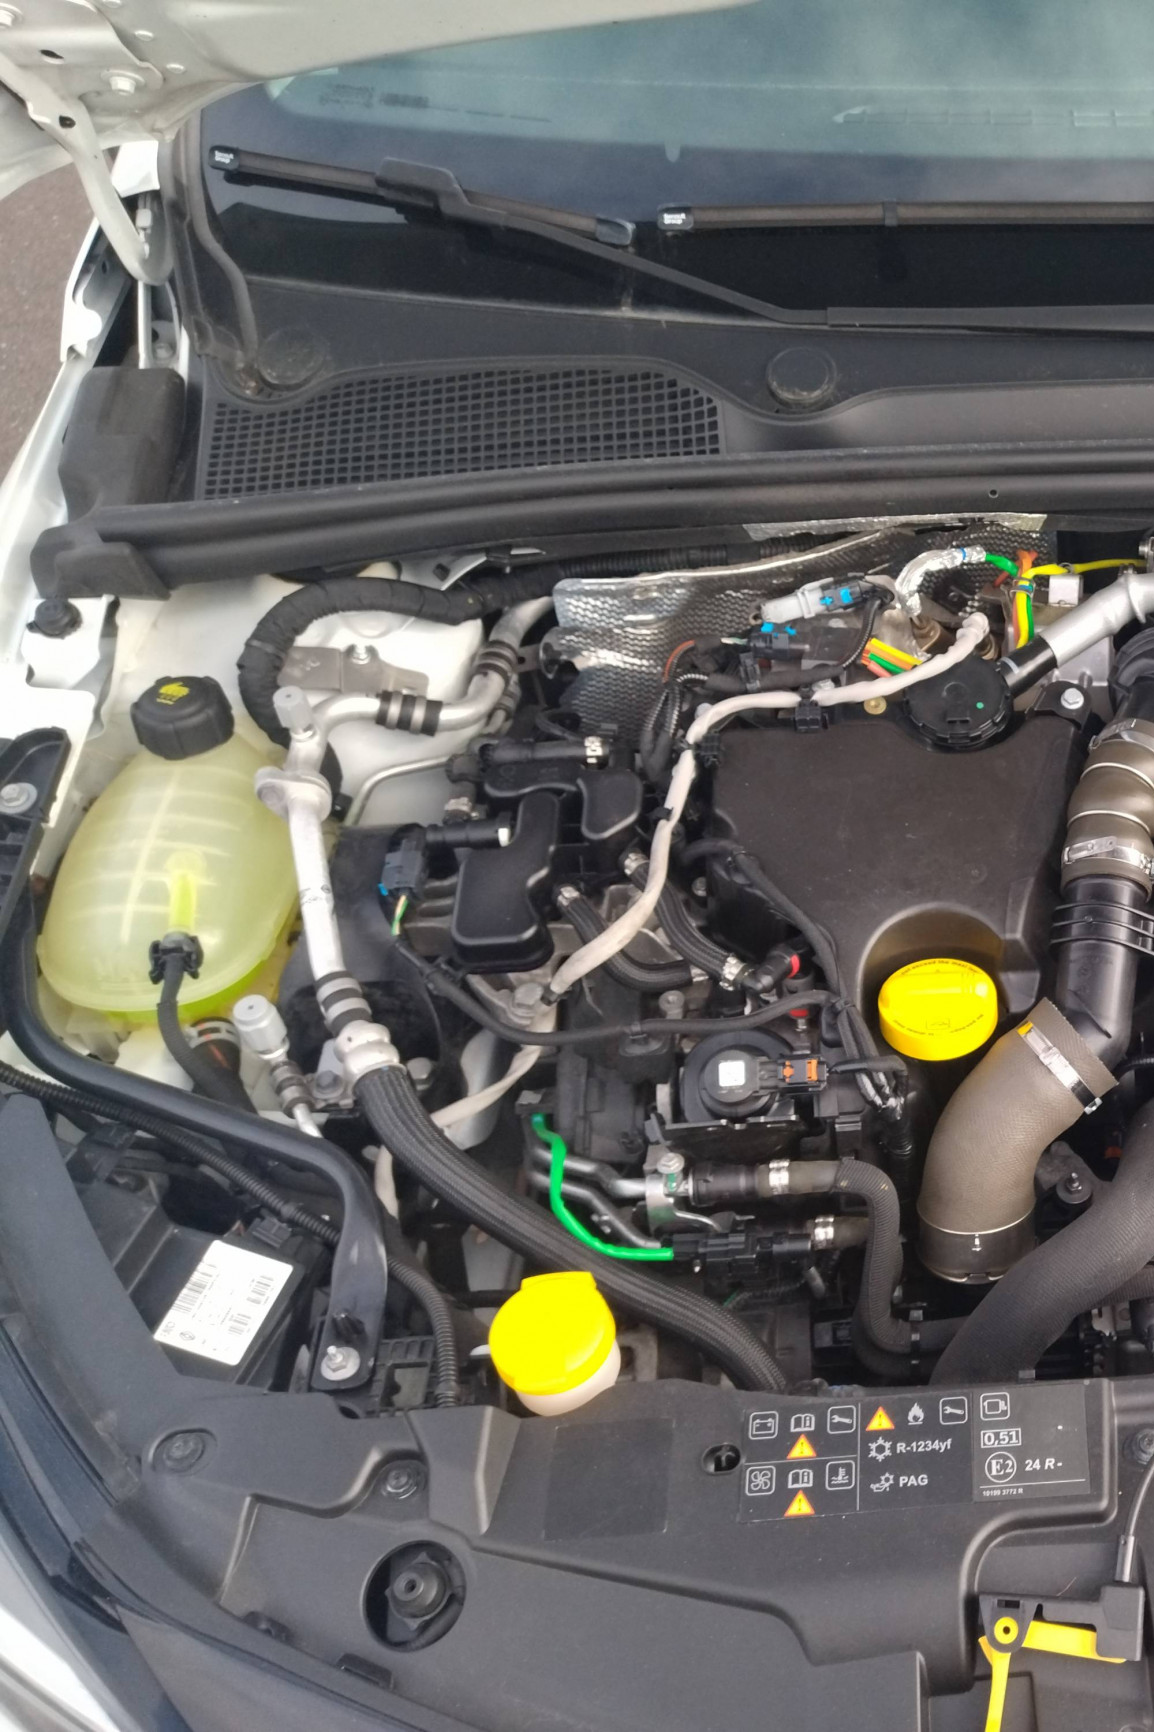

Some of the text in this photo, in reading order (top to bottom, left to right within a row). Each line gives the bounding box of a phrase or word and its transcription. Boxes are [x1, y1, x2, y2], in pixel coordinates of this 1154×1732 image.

[896, 1438, 953, 1454] R-1234yf
[984, 1430, 1019, 1446] 0,51
[990, 1458, 1014, 1476] E2
[1025, 1458, 1041, 1471] 24
[899, 1474, 929, 1488] PAG
